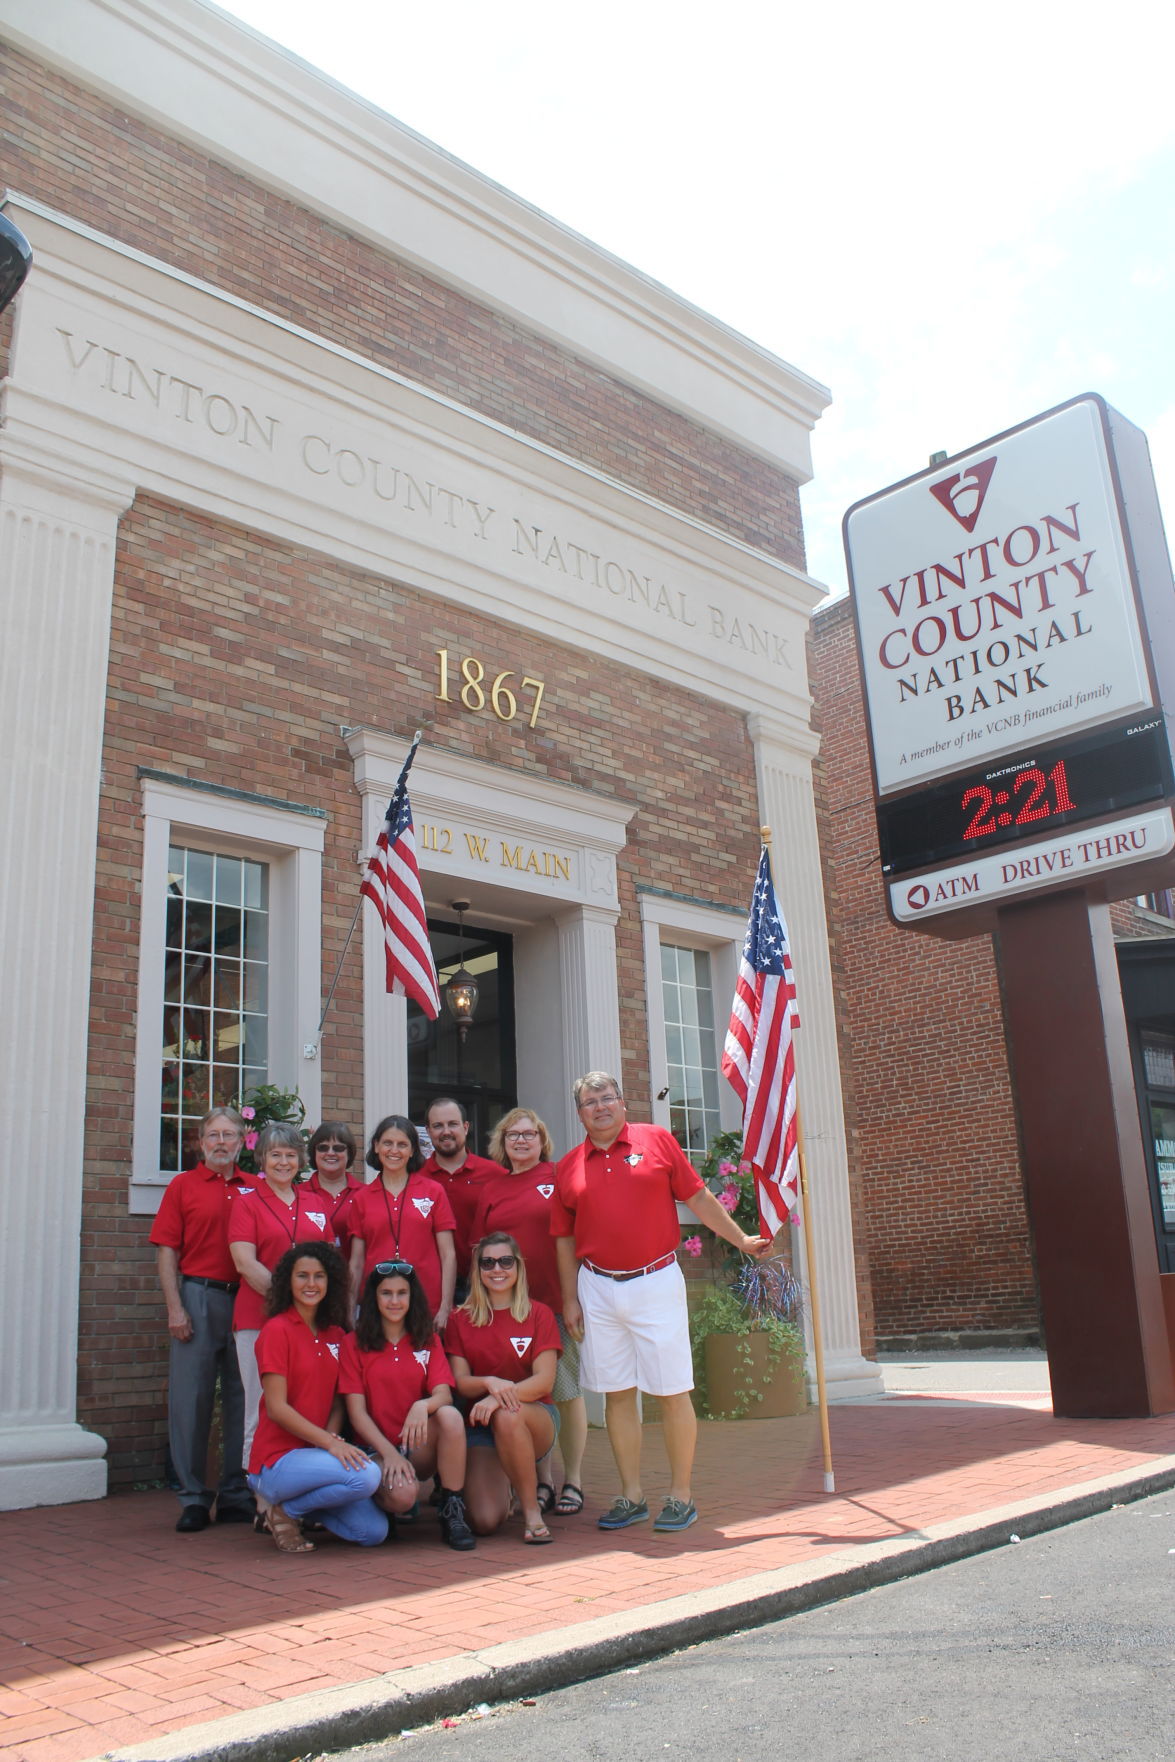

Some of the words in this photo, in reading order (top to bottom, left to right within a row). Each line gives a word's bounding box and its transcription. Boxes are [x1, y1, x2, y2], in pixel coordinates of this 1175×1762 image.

[56, 327, 280, 451] VINTON
[303, 435, 496, 540] COUNTY
[512, 518, 697, 627] NATIONAL
[708, 605, 793, 671] BANK
[878, 502, 1081, 617] VINTON
[879, 550, 1097, 670] COUNTY
[434, 649, 545, 729] 1867
[897, 610, 1093, 703] NATIONAL
[944, 662, 1049, 721] BANK
[900, 753, 908, 765] A
[910, 739, 952, 760] member
[954, 731, 965, 749] of
[966, 728, 983, 742] the
[986, 713, 1021, 735] VCNB
[1022, 695, 1073, 726] financial
[1074, 683, 1113, 709] family
[961, 760, 1077, 840] 2:21
[986, 759, 1036, 780] DAKTRONICS
[422, 823, 453, 854] 112
[464, 832, 490, 863] W.
[501, 841, 572, 881] MAIN
[934, 873, 980, 902] ATM
[1001, 847, 1074, 884] DRIVE
[1078, 827, 1148, 863] THRU
